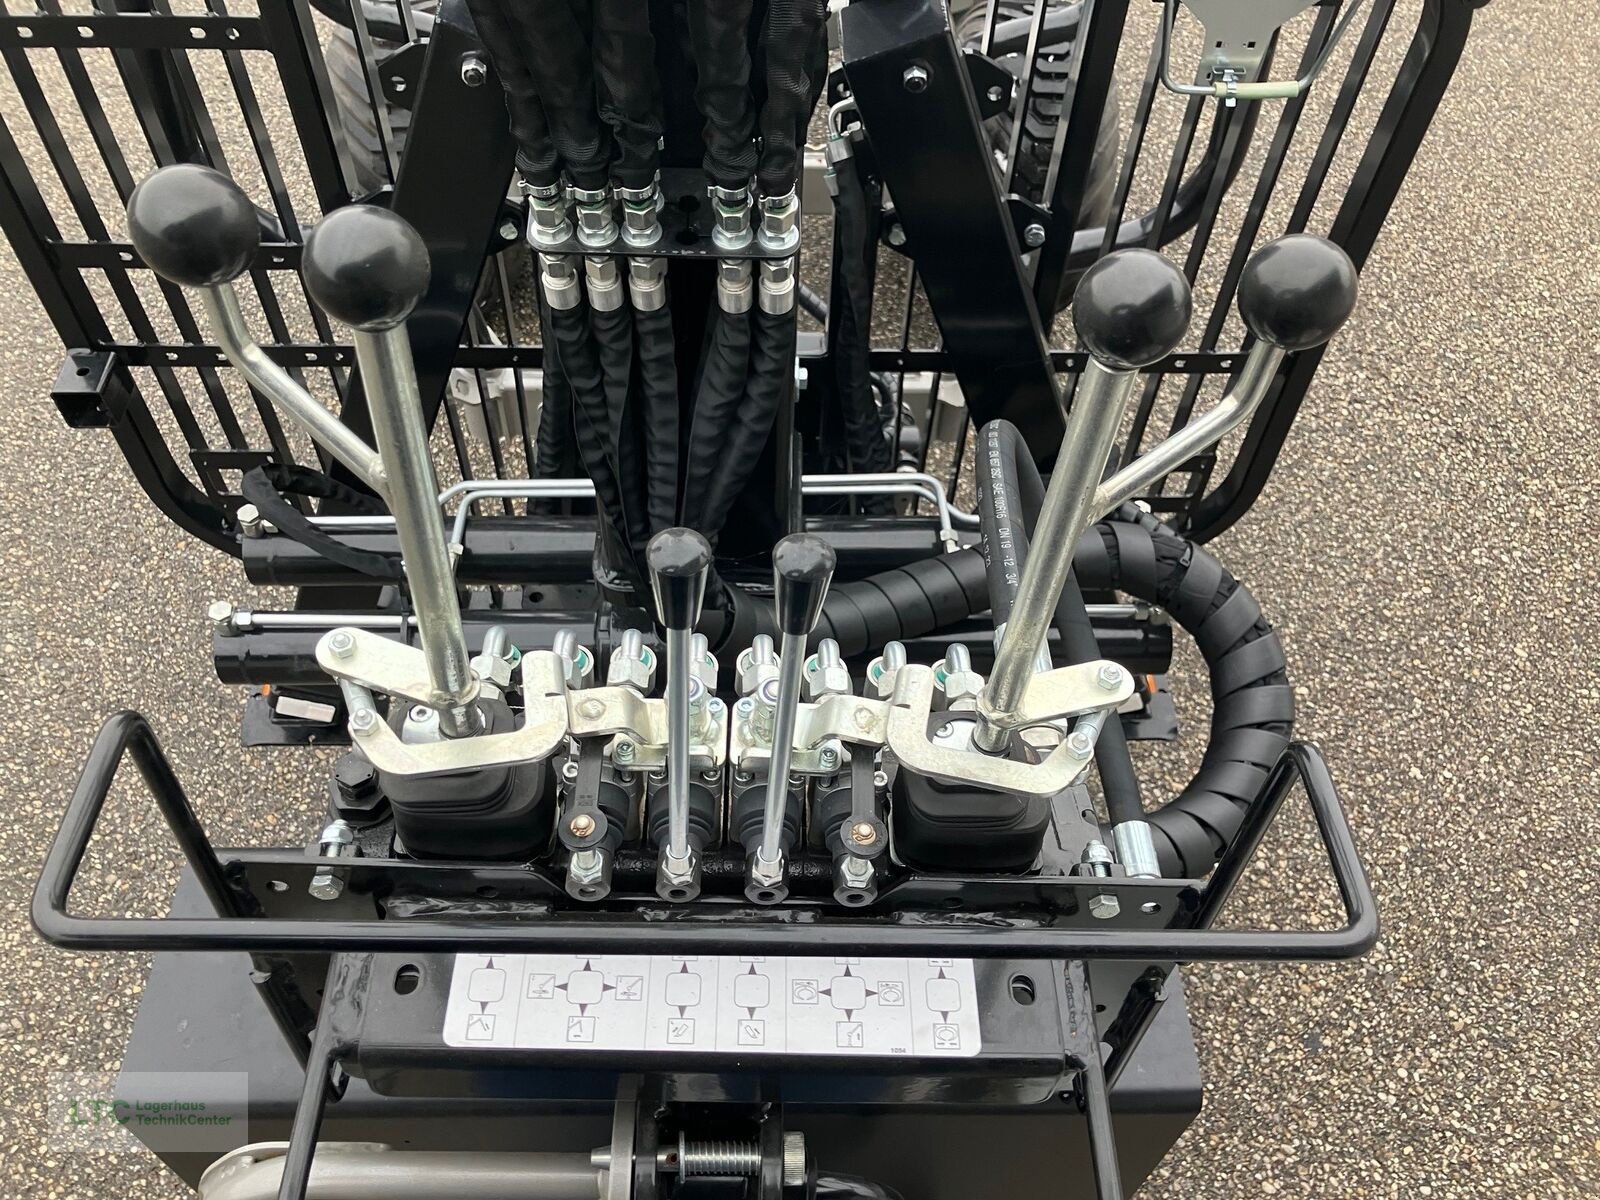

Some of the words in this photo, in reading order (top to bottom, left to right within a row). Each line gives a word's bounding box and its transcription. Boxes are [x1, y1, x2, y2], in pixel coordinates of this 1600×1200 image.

[992, 483, 1003, 495] SAE
[994, 496, 1007, 519] 100R16
[999, 528, 1010, 538] DN
[1001, 541, 1012, 549] 19
